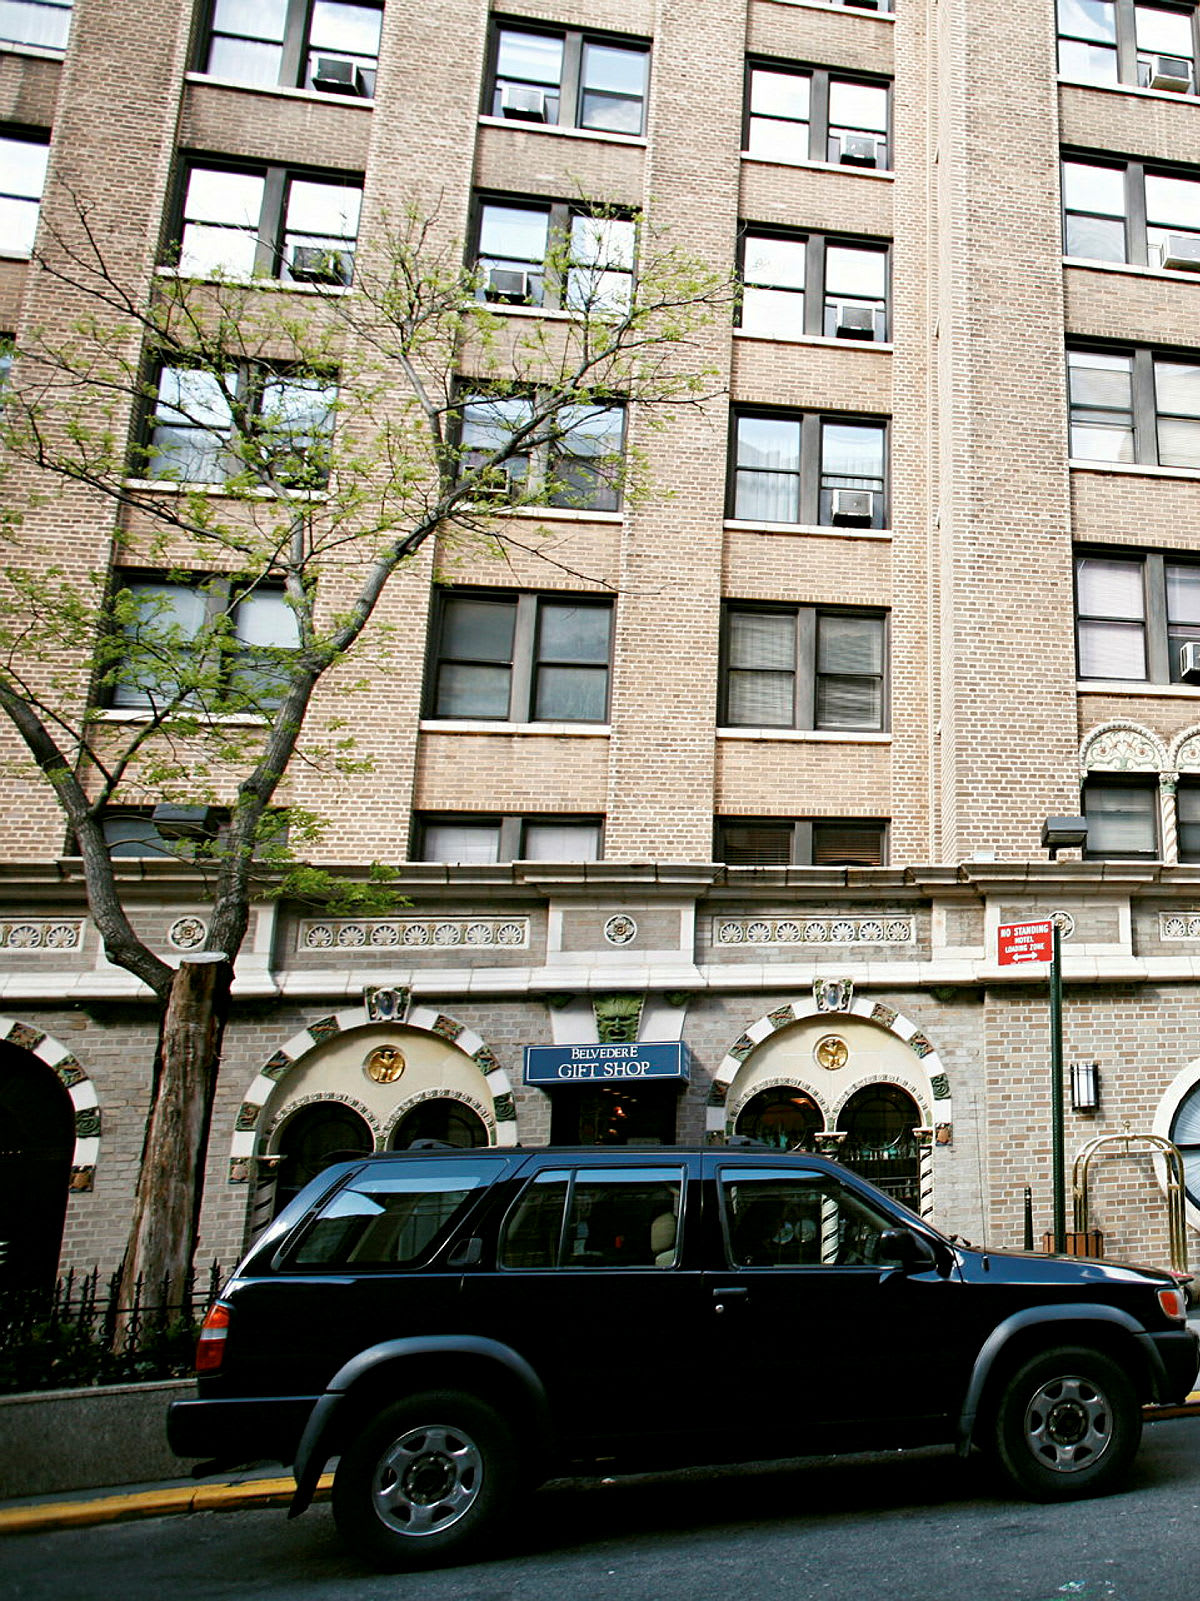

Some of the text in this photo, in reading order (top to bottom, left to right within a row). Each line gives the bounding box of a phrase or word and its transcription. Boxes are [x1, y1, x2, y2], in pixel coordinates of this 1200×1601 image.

[1000, 924, 1049, 938] NO STANDING
[1014, 936, 1034, 944] HOTEL
[571, 1046, 639, 1060] BELVEDERE
[558, 1061, 650, 1079] GIFT SHOP
